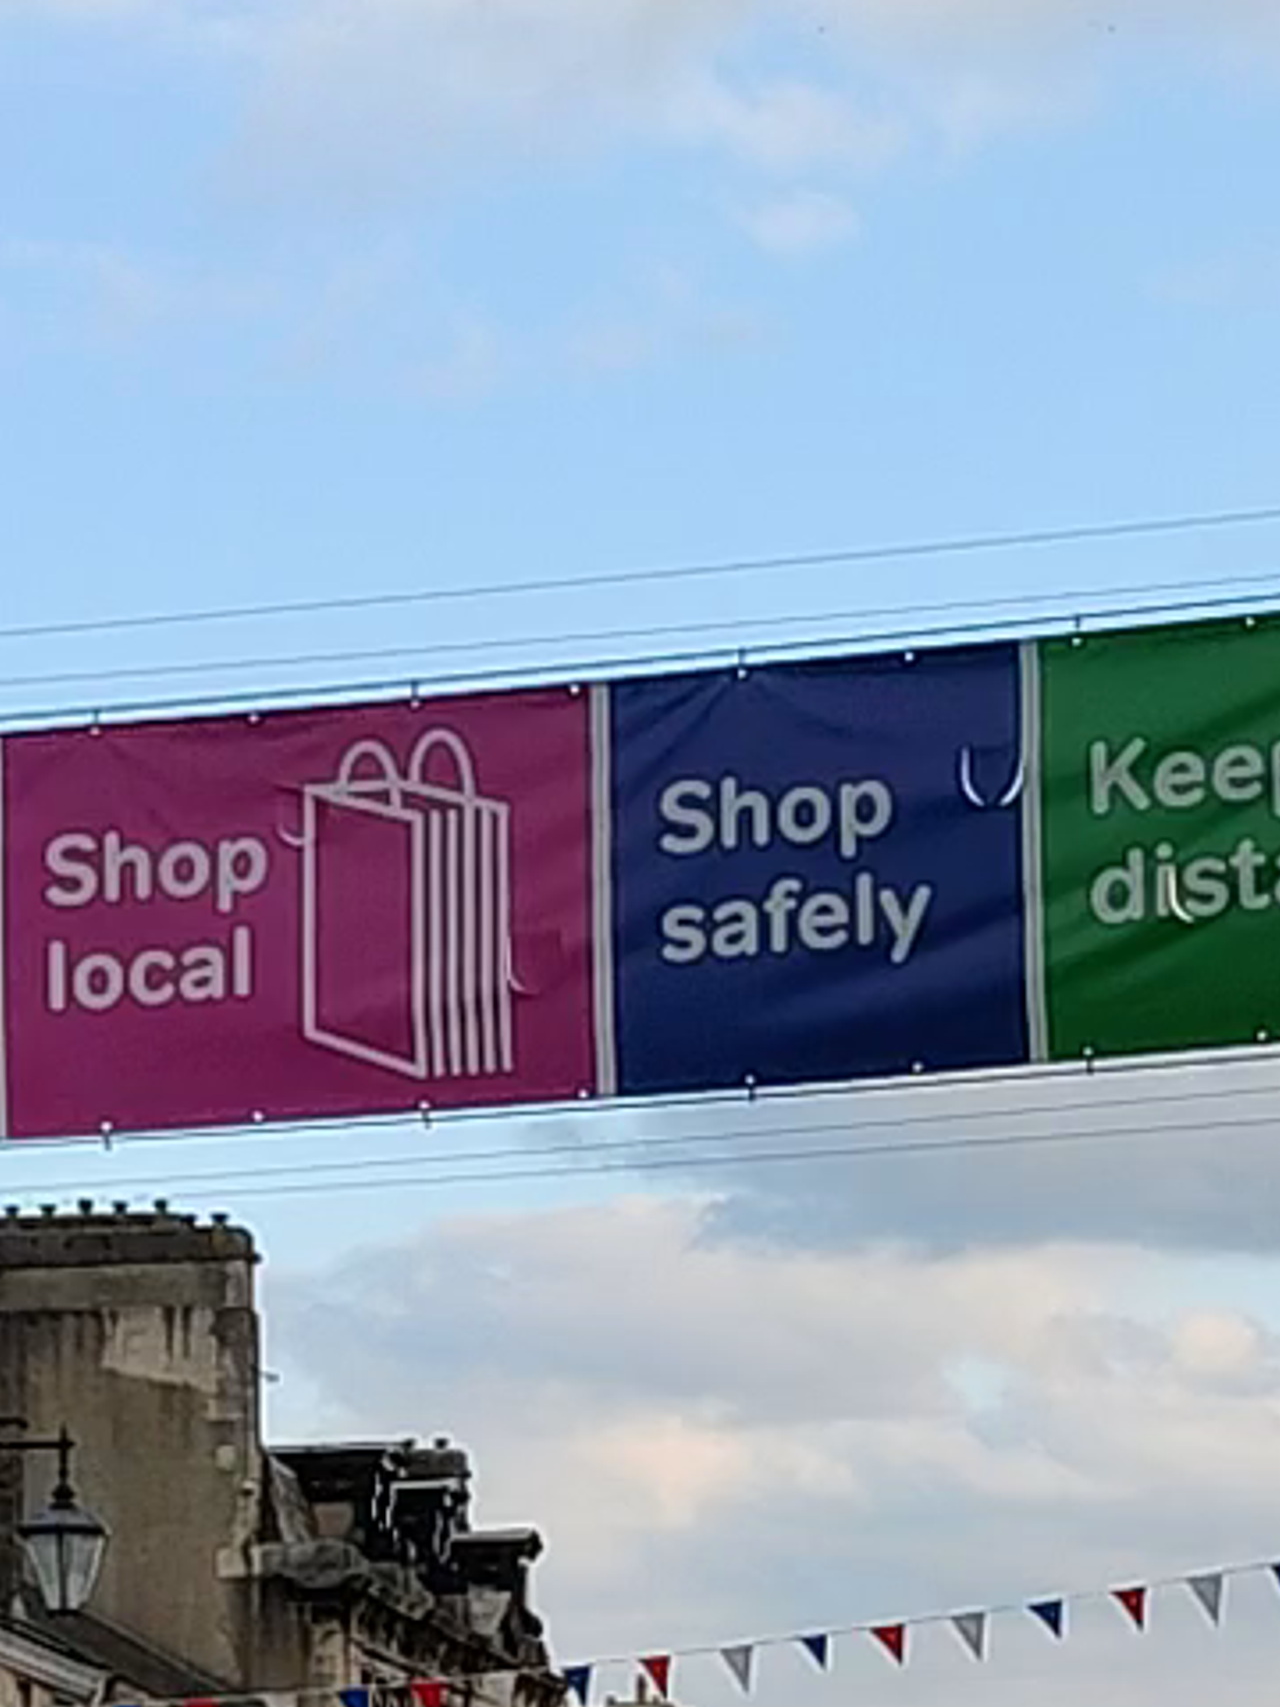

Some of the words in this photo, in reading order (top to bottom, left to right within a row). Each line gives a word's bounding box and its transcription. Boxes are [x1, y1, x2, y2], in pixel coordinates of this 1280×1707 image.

[658, 775, 893, 859] Shop
[44, 829, 269, 914] Shop
[661, 871, 932, 964] safely
[47, 925, 252, 1013] local
